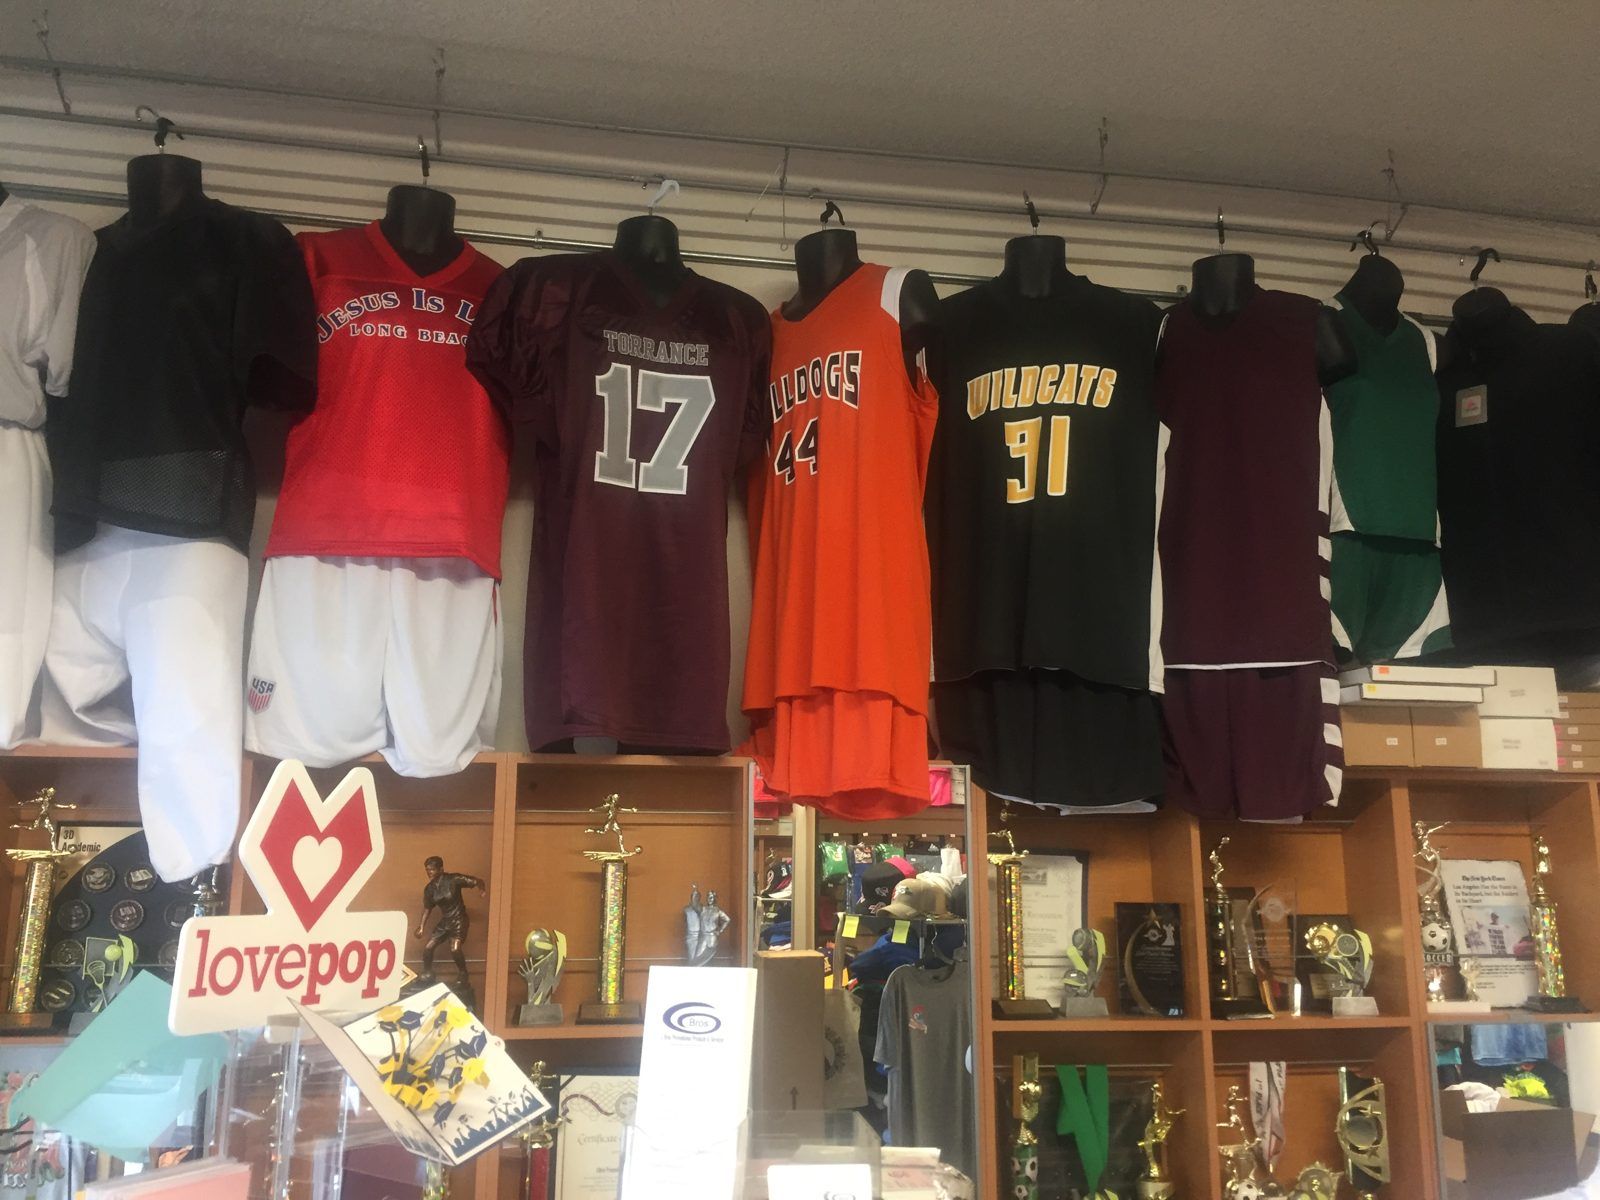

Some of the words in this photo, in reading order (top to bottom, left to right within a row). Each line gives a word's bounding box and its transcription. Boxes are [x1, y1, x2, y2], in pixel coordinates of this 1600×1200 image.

[455, 300, 476, 325] L
[350, 323, 407, 338] LONG
[418, 329, 469, 346] BEA
[603, 329, 709, 366] TORRANCE
[770, 350, 862, 423] LLDOGS
[966, 363, 1118, 420] WILDCATS
[594, 362, 716, 495] 17
[774, 416, 818, 485] 44
[252, 678, 274, 694] USA
[61, 841, 101, 853] Acdemic
[63, 829, 75, 840] 3D
[188, 929, 396, 1006] lovepop
[1423, 953, 1453, 963] OCCER
[688, 1018, 709, 1028] Bros
